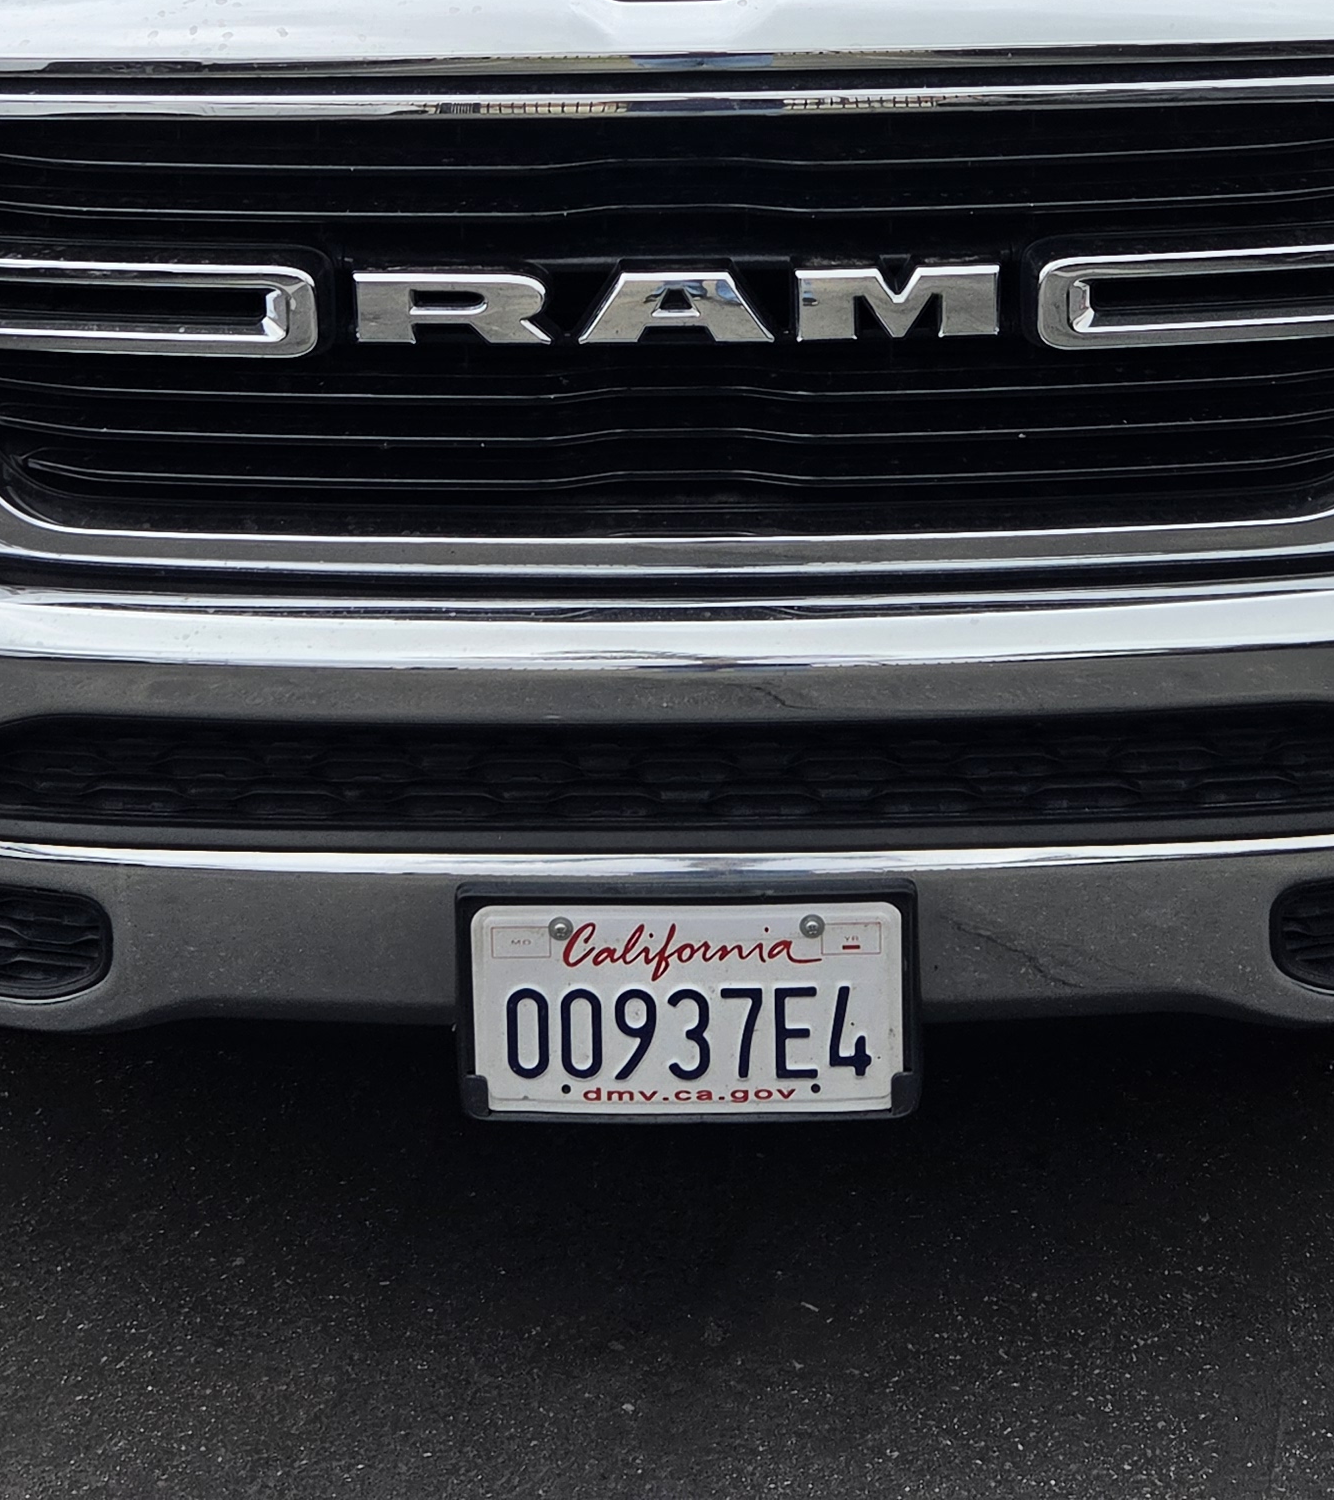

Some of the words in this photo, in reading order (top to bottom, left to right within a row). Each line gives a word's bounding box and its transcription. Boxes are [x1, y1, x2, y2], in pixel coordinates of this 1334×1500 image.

[353, 265, 999, 345] RAM
[563, 921, 822, 983] California
[506, 986, 872, 1081] 00937E4
[583, 1086, 797, 1104] dmv.ca.gov
